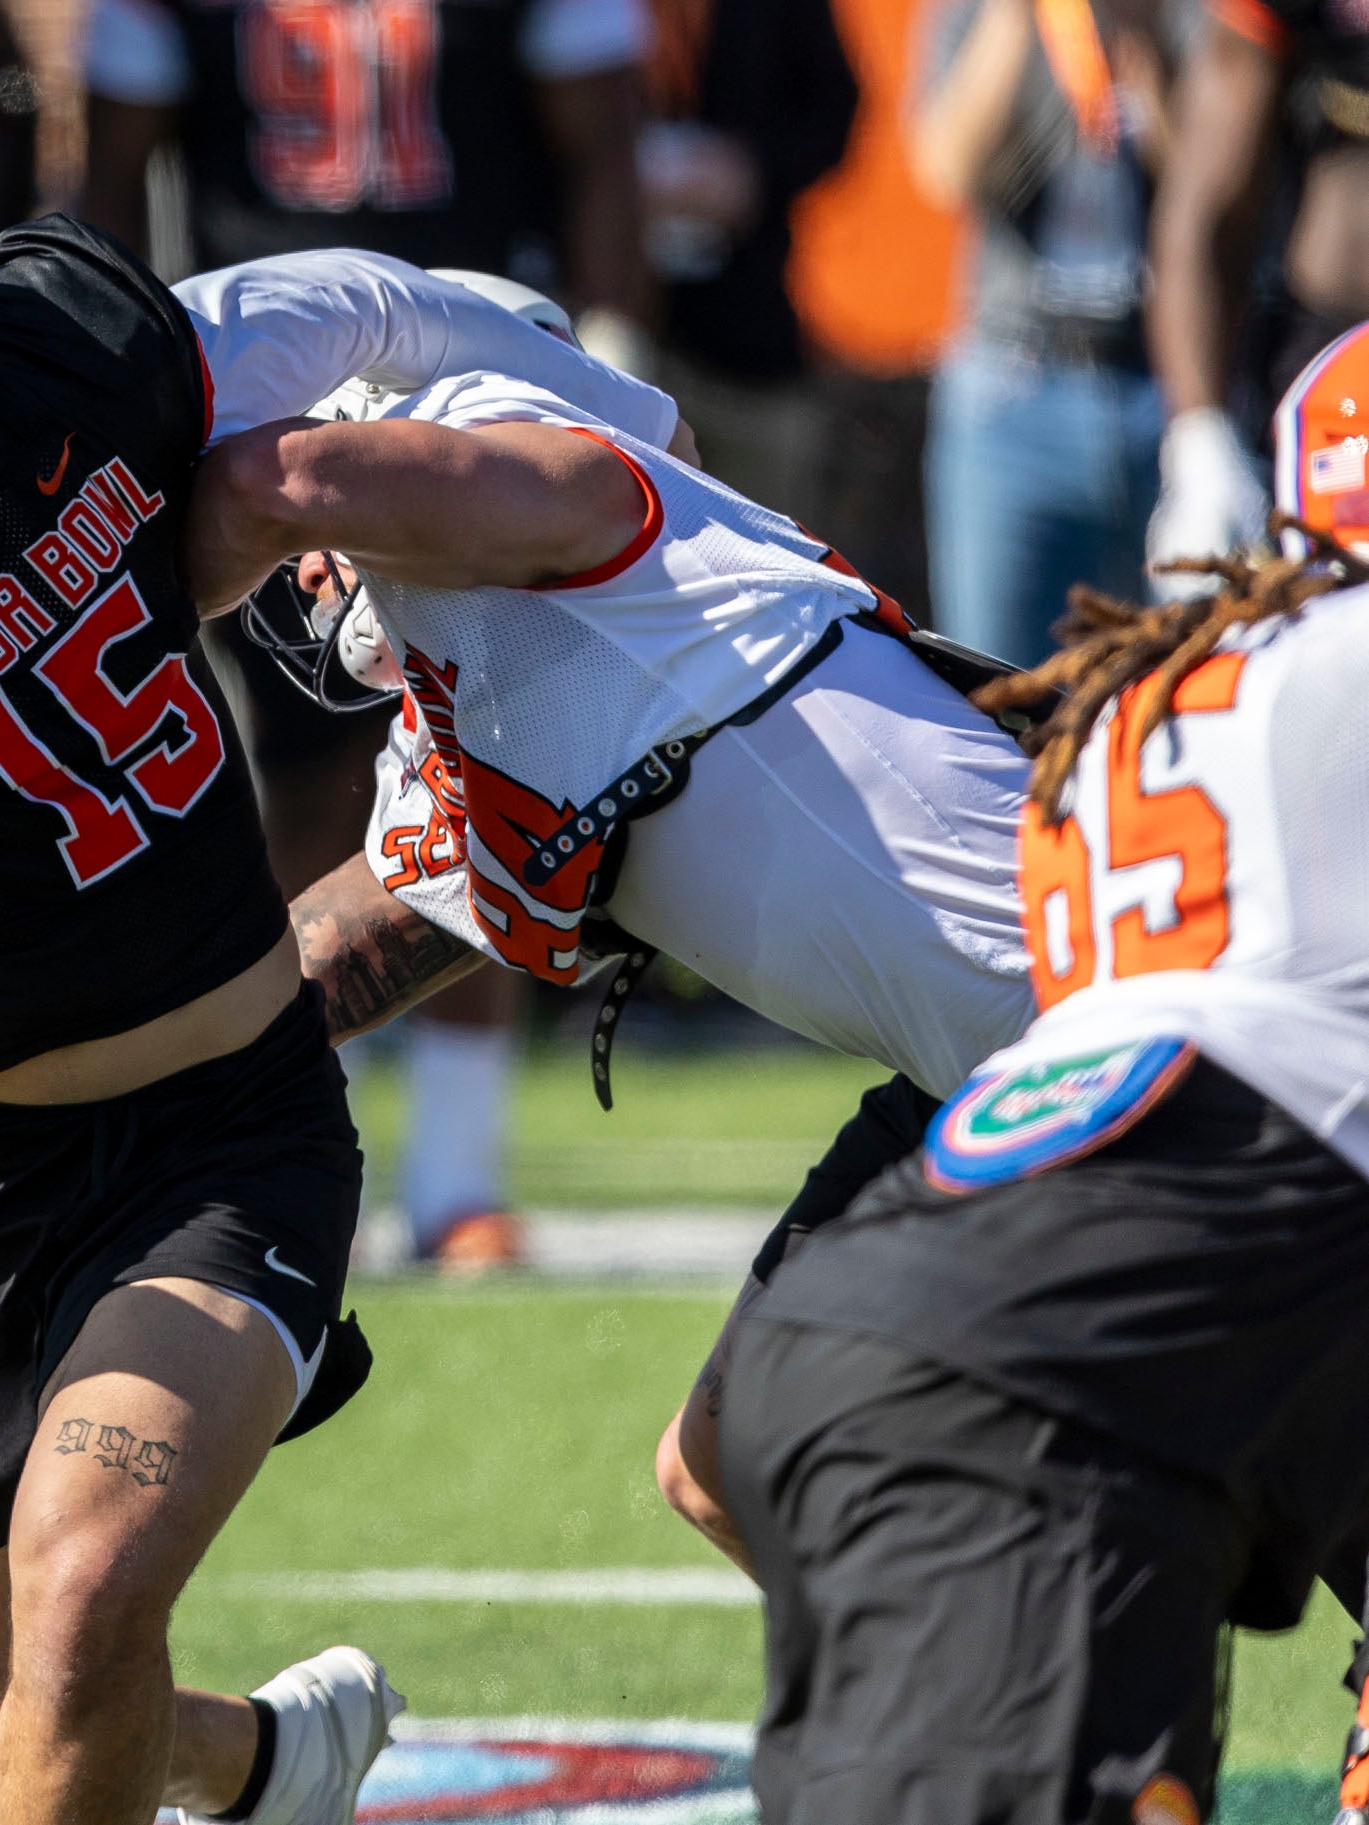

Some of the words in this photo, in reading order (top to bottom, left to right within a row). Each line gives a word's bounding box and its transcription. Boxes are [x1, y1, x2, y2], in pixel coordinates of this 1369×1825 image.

[233, 0, 453, 212] 91
[22, 457, 166, 610] BOWL
[55, 1417, 179, 1487] 999
